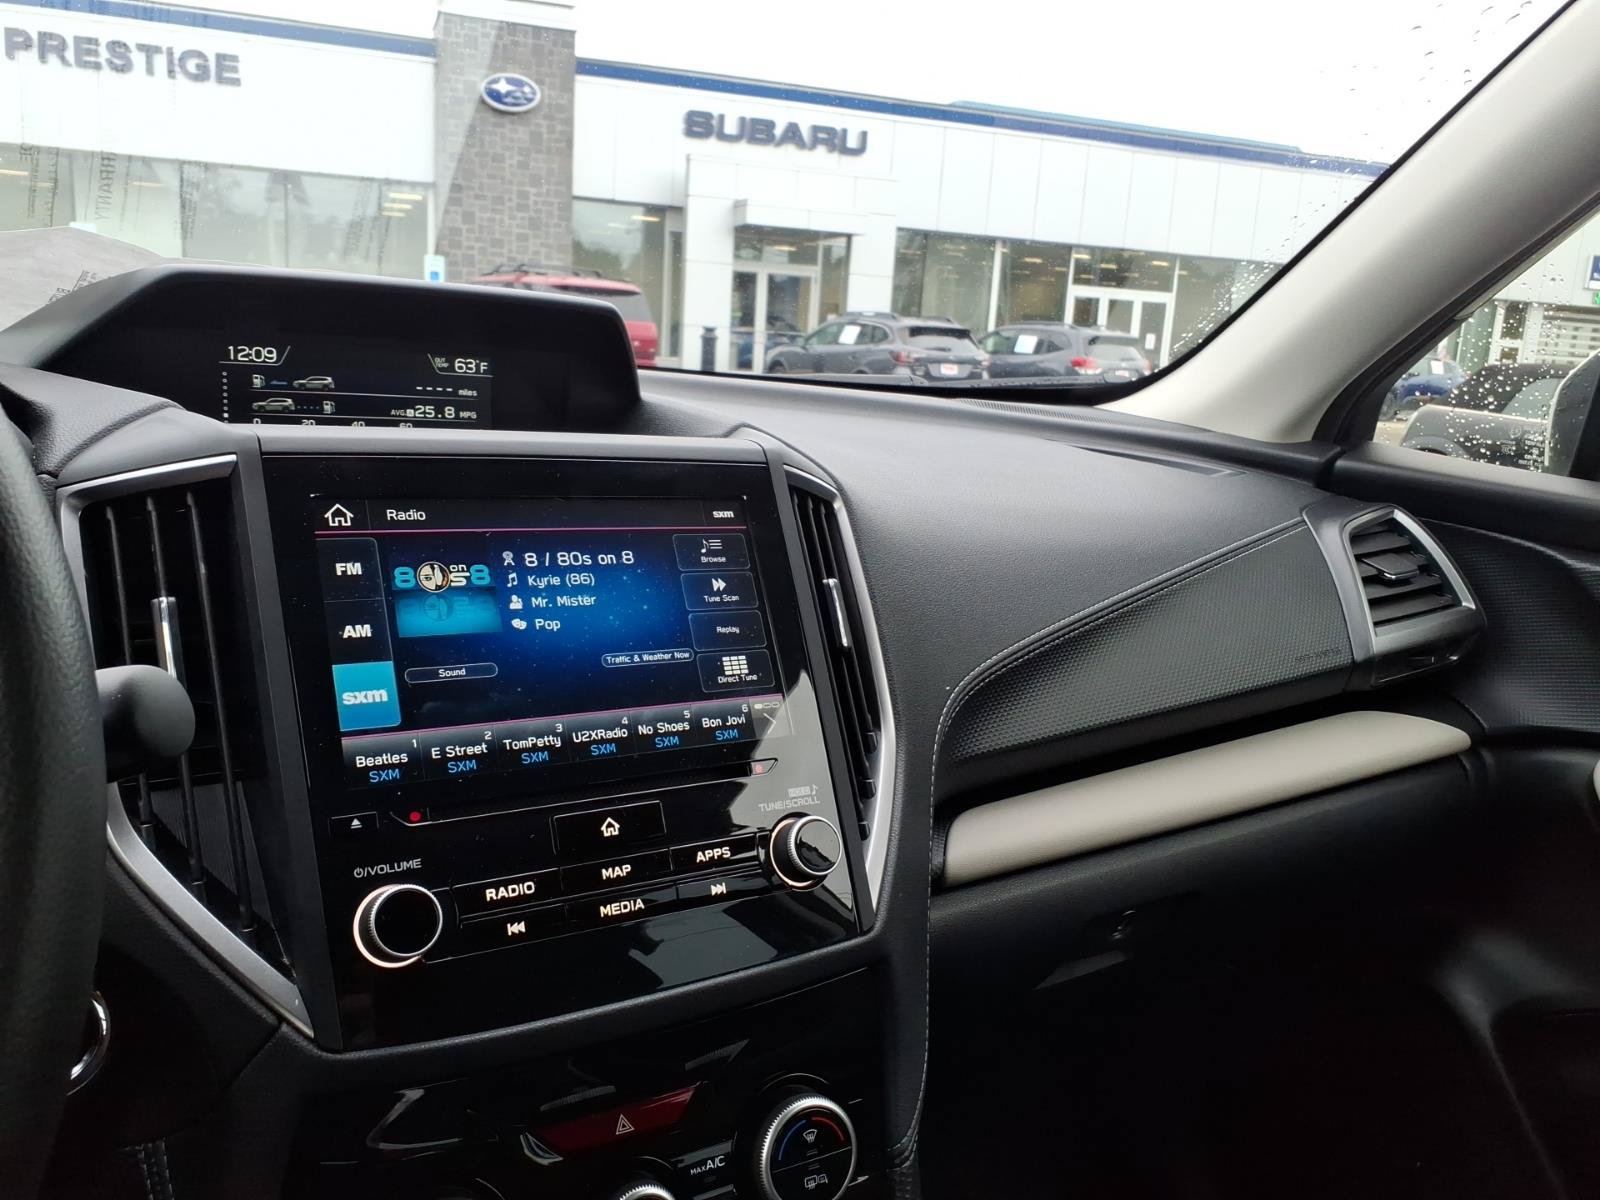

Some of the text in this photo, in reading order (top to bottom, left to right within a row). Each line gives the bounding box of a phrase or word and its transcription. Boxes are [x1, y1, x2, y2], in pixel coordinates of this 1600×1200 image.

[4, 27, 241, 86] PRESTIGE
[682, 109, 868, 157] SUBARU
[228, 345, 277, 362] 12:09
[415, 405, 455, 419] 25.8
[459, 411, 477, 419] MPG
[386, 509, 426, 521] Radio
[712, 510, 735, 519] sxm
[524, 552, 538, 567] 8
[557, 551, 592, 566] 80s
[598, 553, 616, 565] on
[621, 550, 635, 565] 8
[335, 562, 362, 576] FM
[527, 572, 595, 589] Kyrie (86)
[531, 594, 596, 608] Mr. Mister
[704, 595, 720, 603] Tune
[343, 624, 372, 639] AM
[535, 618, 561, 632] Pop
[716, 626, 740, 634] Replay
[606, 651, 690, 664] Traffic & Weather Now
[438, 667, 466, 678] Sound
[718, 673, 758, 684] Direct Tune
[342, 688, 389, 706] sxm
[683, 710, 691, 719] 5
[741, 704, 748, 713] 6
[621, 716, 628, 725] 4
[638, 720, 690, 735] No Shoes
[702, 713, 746, 728] Bon Jovi
[555, 723, 563, 733] 3
[572, 727, 628, 743] U2XRadio
[715, 729, 738, 741] SXM
[484, 731, 492, 740] 2
[503, 735, 561, 750] TomPetty
[655, 736, 679, 748] SXM
[412, 739, 417, 748] 1
[590, 743, 616, 756] SXM
[431, 743, 488, 759] E Street
[521, 751, 549, 764] SXM
[355, 752, 408, 768] Beatles
[447, 760, 477, 773] SXM
[369, 768, 400, 783] SXM
[696, 846, 732, 863] APPS
[601, 864, 632, 880] MAP
[485, 881, 536, 901] RADIO
[600, 898, 645, 918] MEDIA
[690, 1155, 726, 1176] MAX A/C
